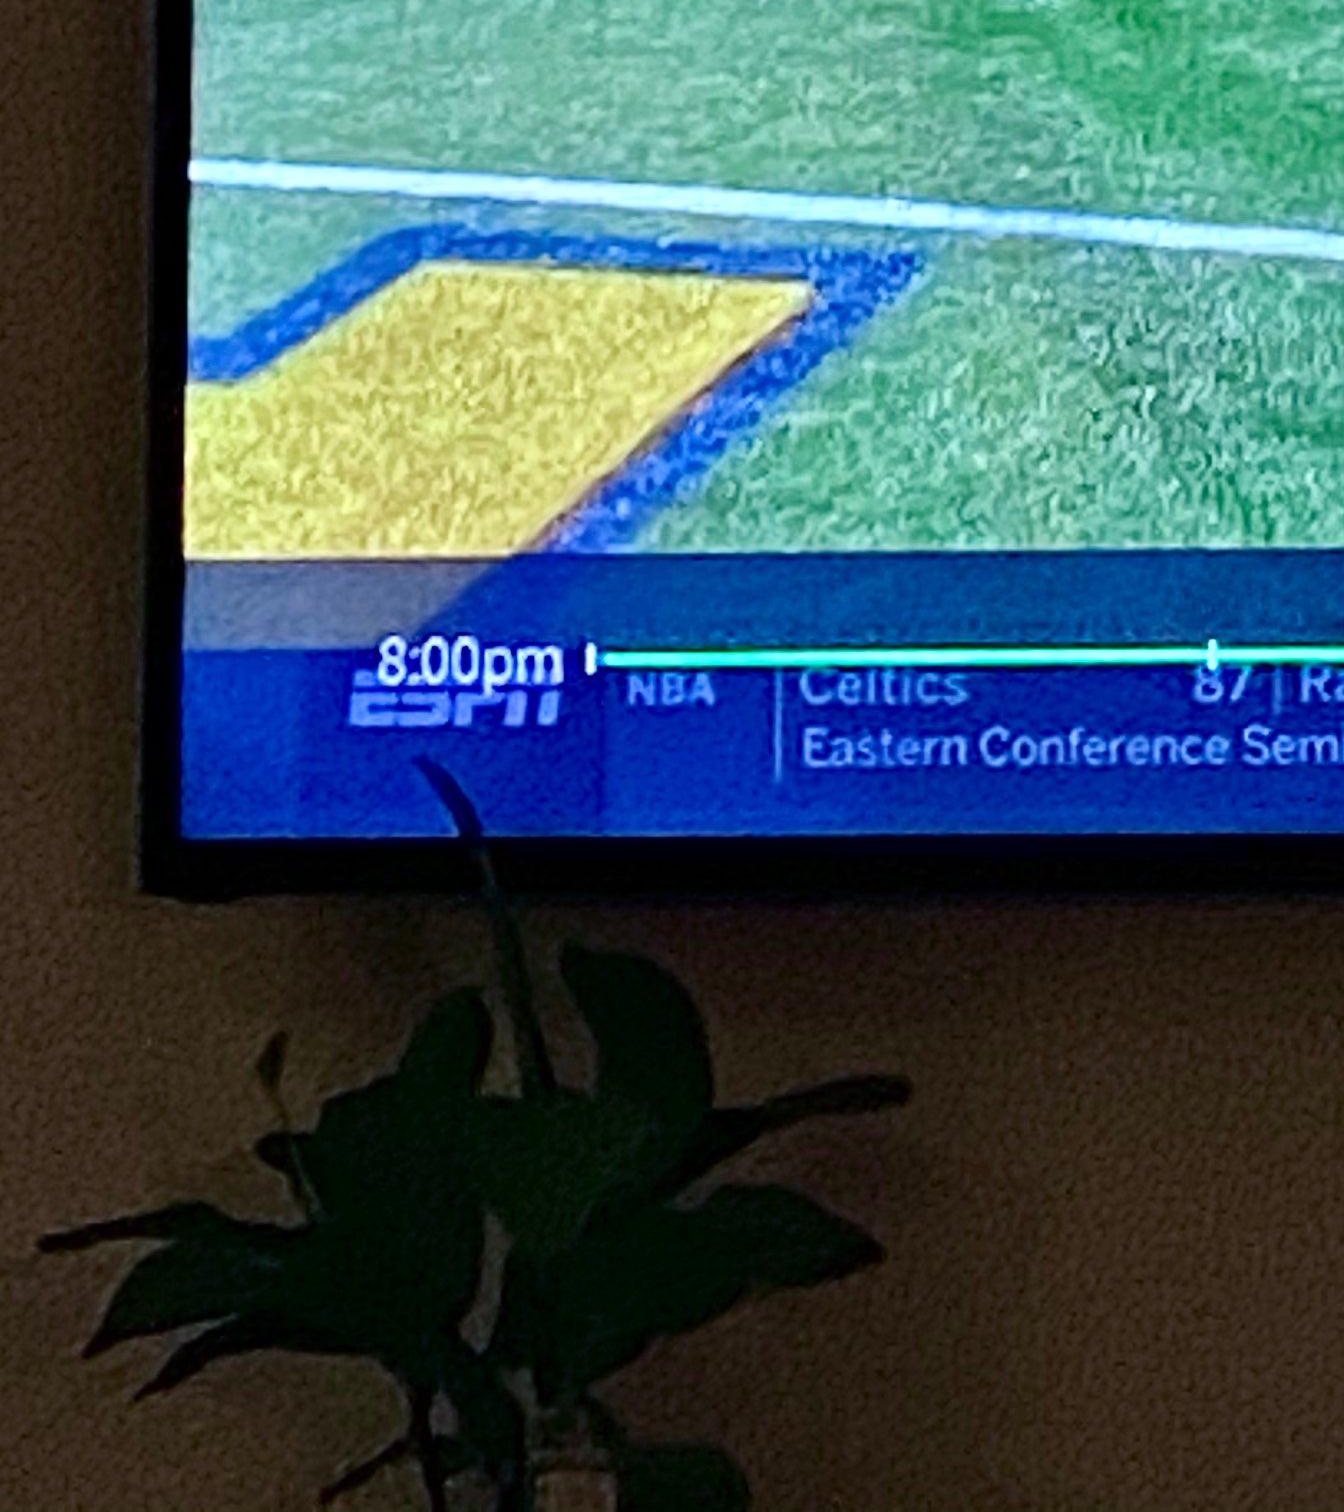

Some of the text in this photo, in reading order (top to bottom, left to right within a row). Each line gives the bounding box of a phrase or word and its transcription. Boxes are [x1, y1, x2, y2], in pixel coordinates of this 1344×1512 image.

[376, 634, 565, 696] 8:00pm
[800, 664, 970, 706] Celtics
[1194, 664, 1249, 703] 87
[627, 672, 715, 706] NBA
[803, 726, 969, 768] Eastern
[978, 724, 1231, 768] Conference
